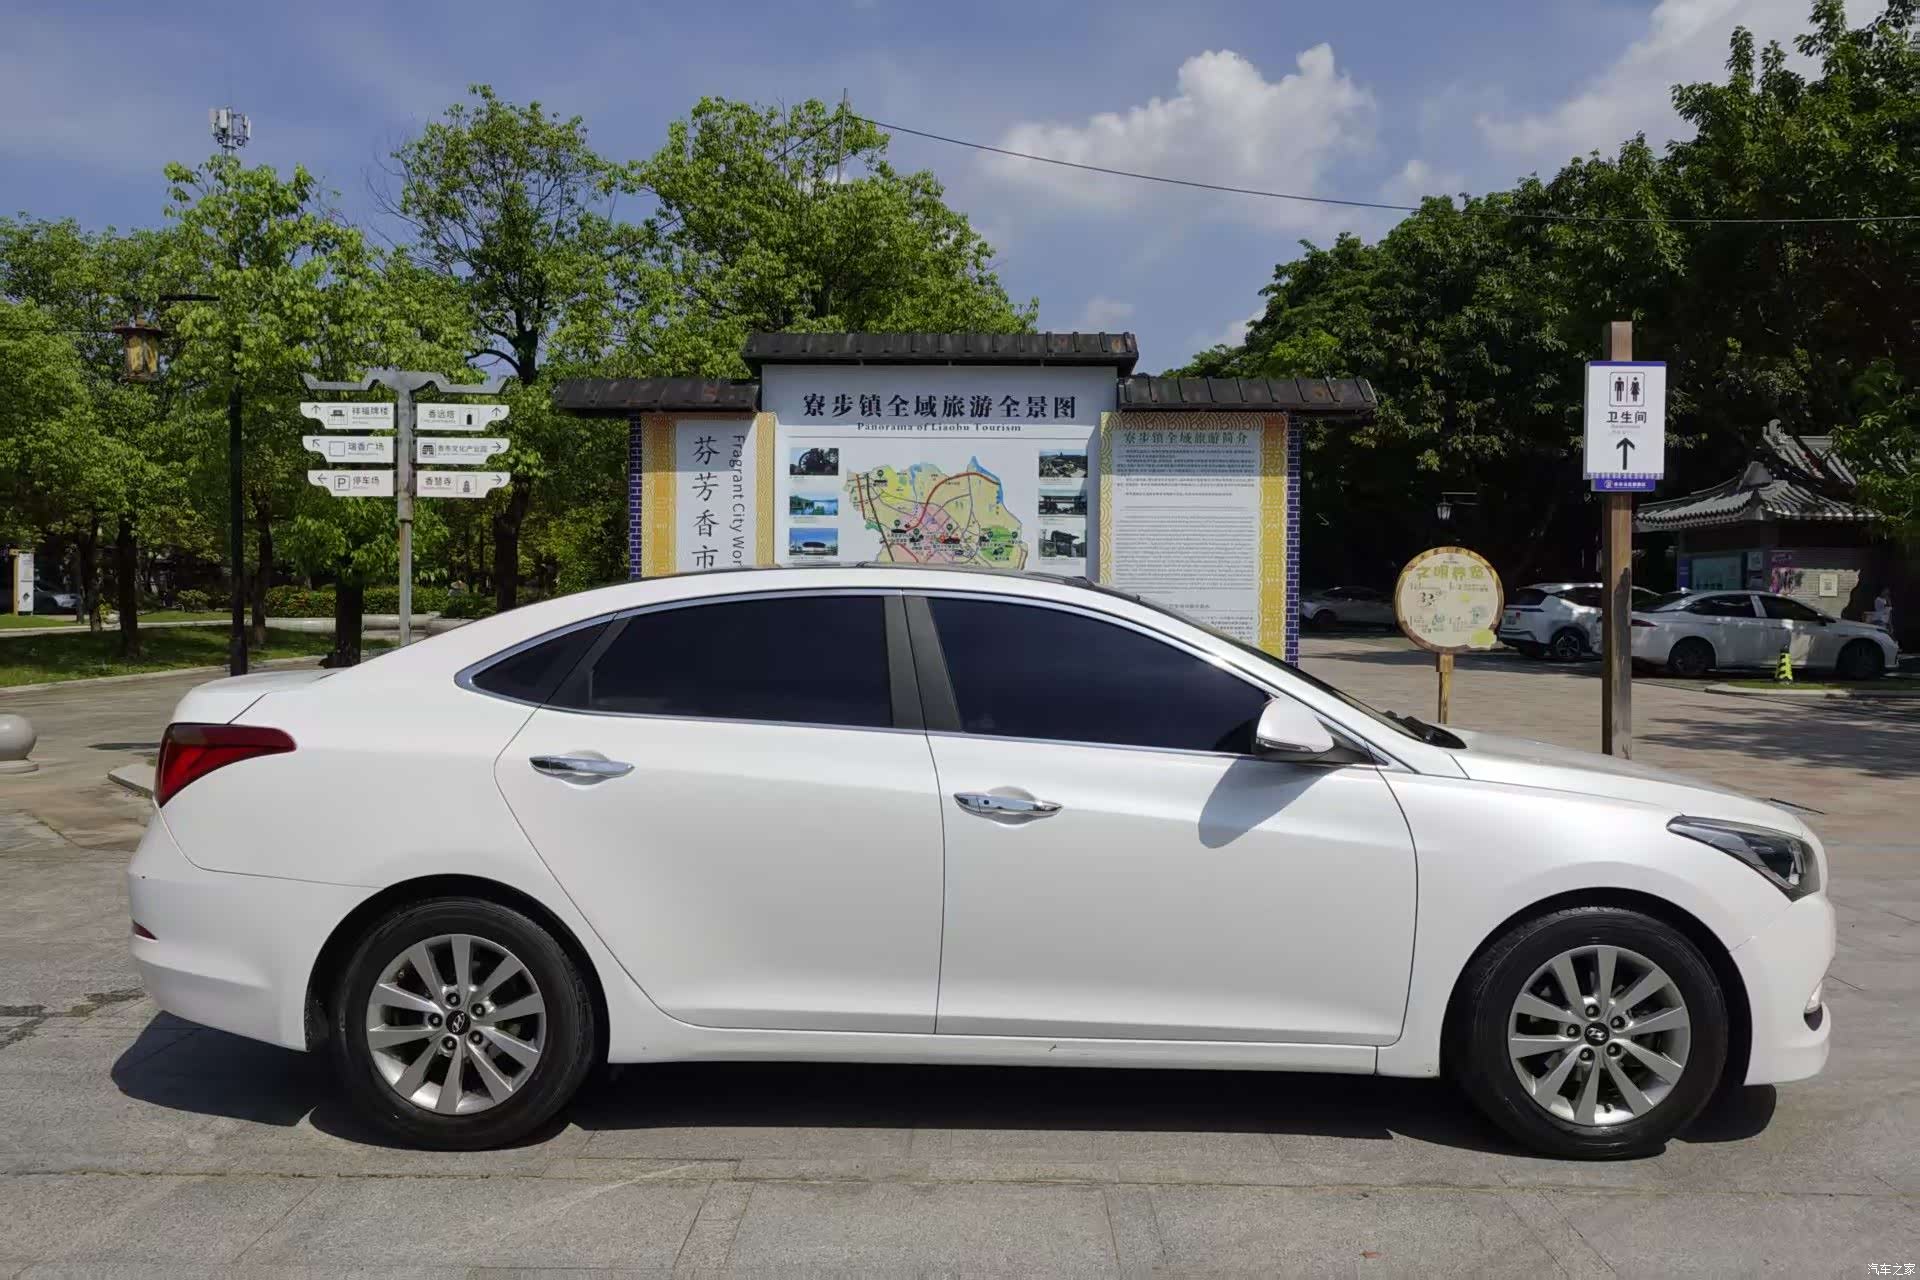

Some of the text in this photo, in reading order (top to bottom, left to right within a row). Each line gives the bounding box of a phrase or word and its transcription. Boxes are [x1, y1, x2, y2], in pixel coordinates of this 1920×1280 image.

[802, 393, 1077, 419] 寮步镇全域旅游全景图
[857, 422, 1022, 432] Panorama of Liaobu Tourism
[1606, 410, 1648, 424] 卫生间
[729, 435, 745, 499] Fragrant
[337, 477, 347, 489] P
[352, 476, 380, 486] 停车场
[691, 435, 721, 569] 芬芳香市
[729, 503, 745, 533] City
